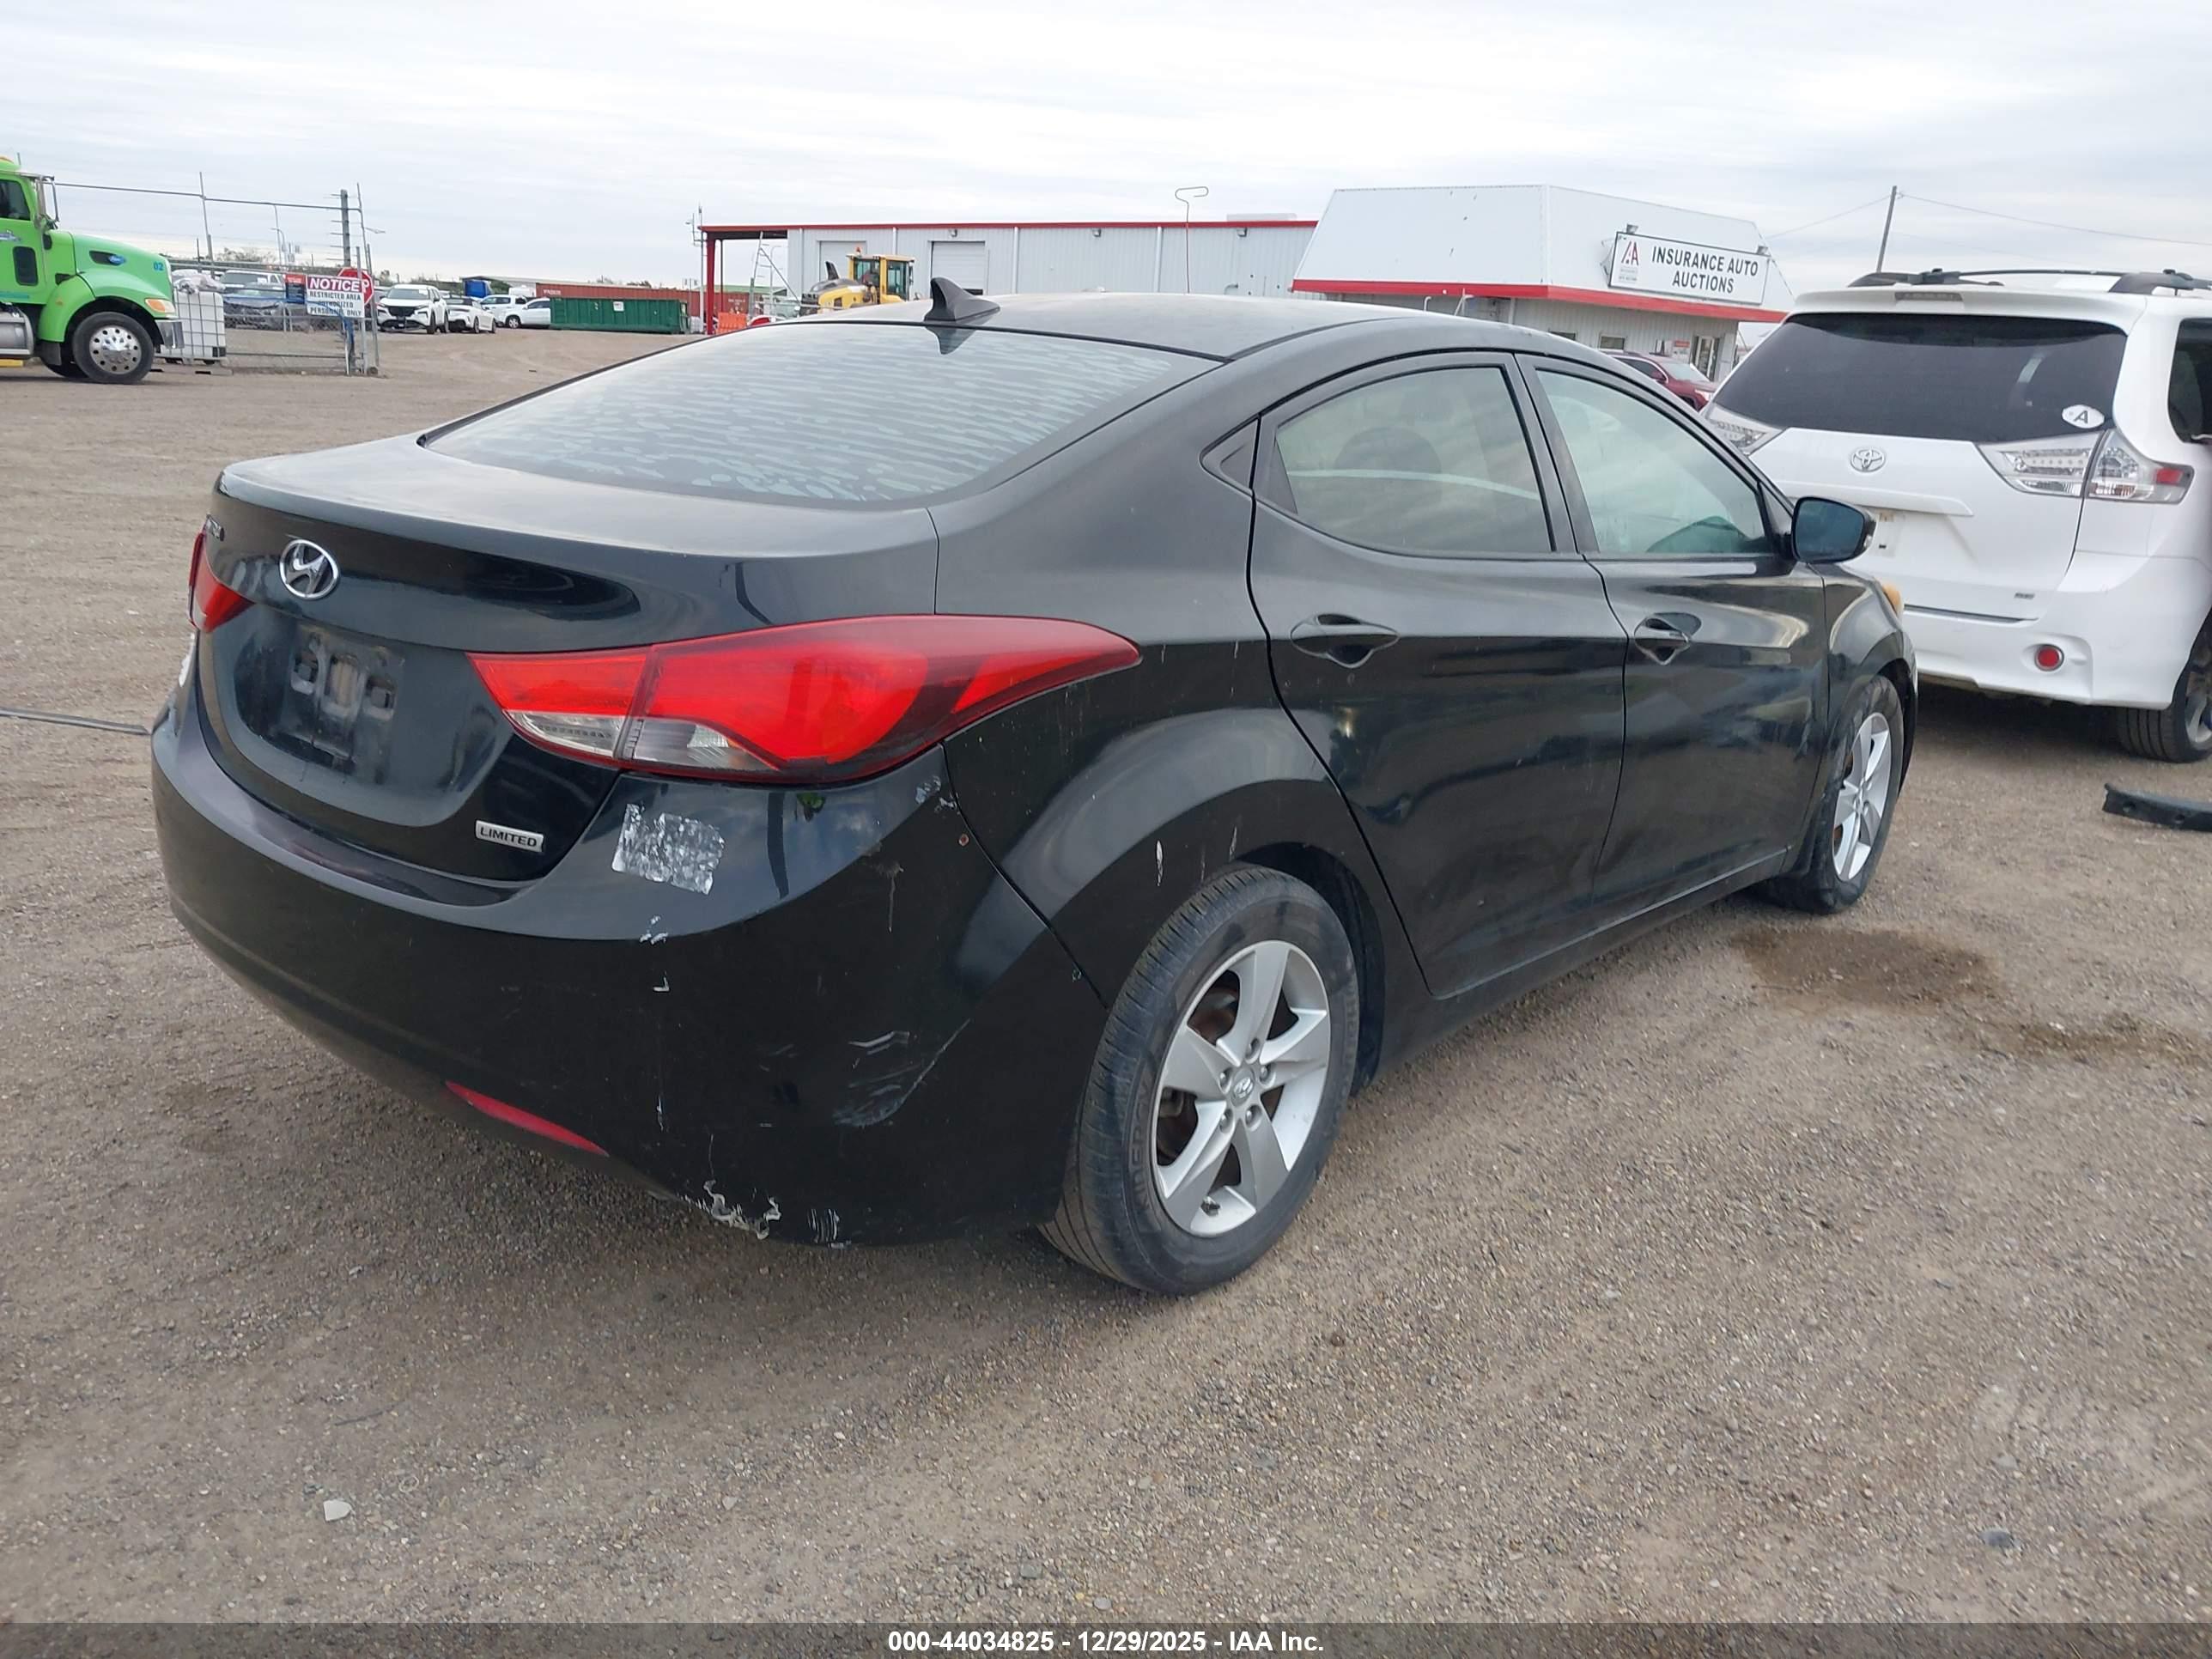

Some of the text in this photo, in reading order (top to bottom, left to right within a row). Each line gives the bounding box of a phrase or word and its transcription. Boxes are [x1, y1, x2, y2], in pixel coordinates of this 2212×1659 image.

[153, 261, 163, 270] 02
[1652, 246, 1759, 276] INSURANCE AUTO
[310, 278, 360, 291] NOTICE
[1672, 270, 1734, 294] AUCTIONS
[2074, 410, 2088, 423] A
[481, 827, 537, 847] LIMITED
